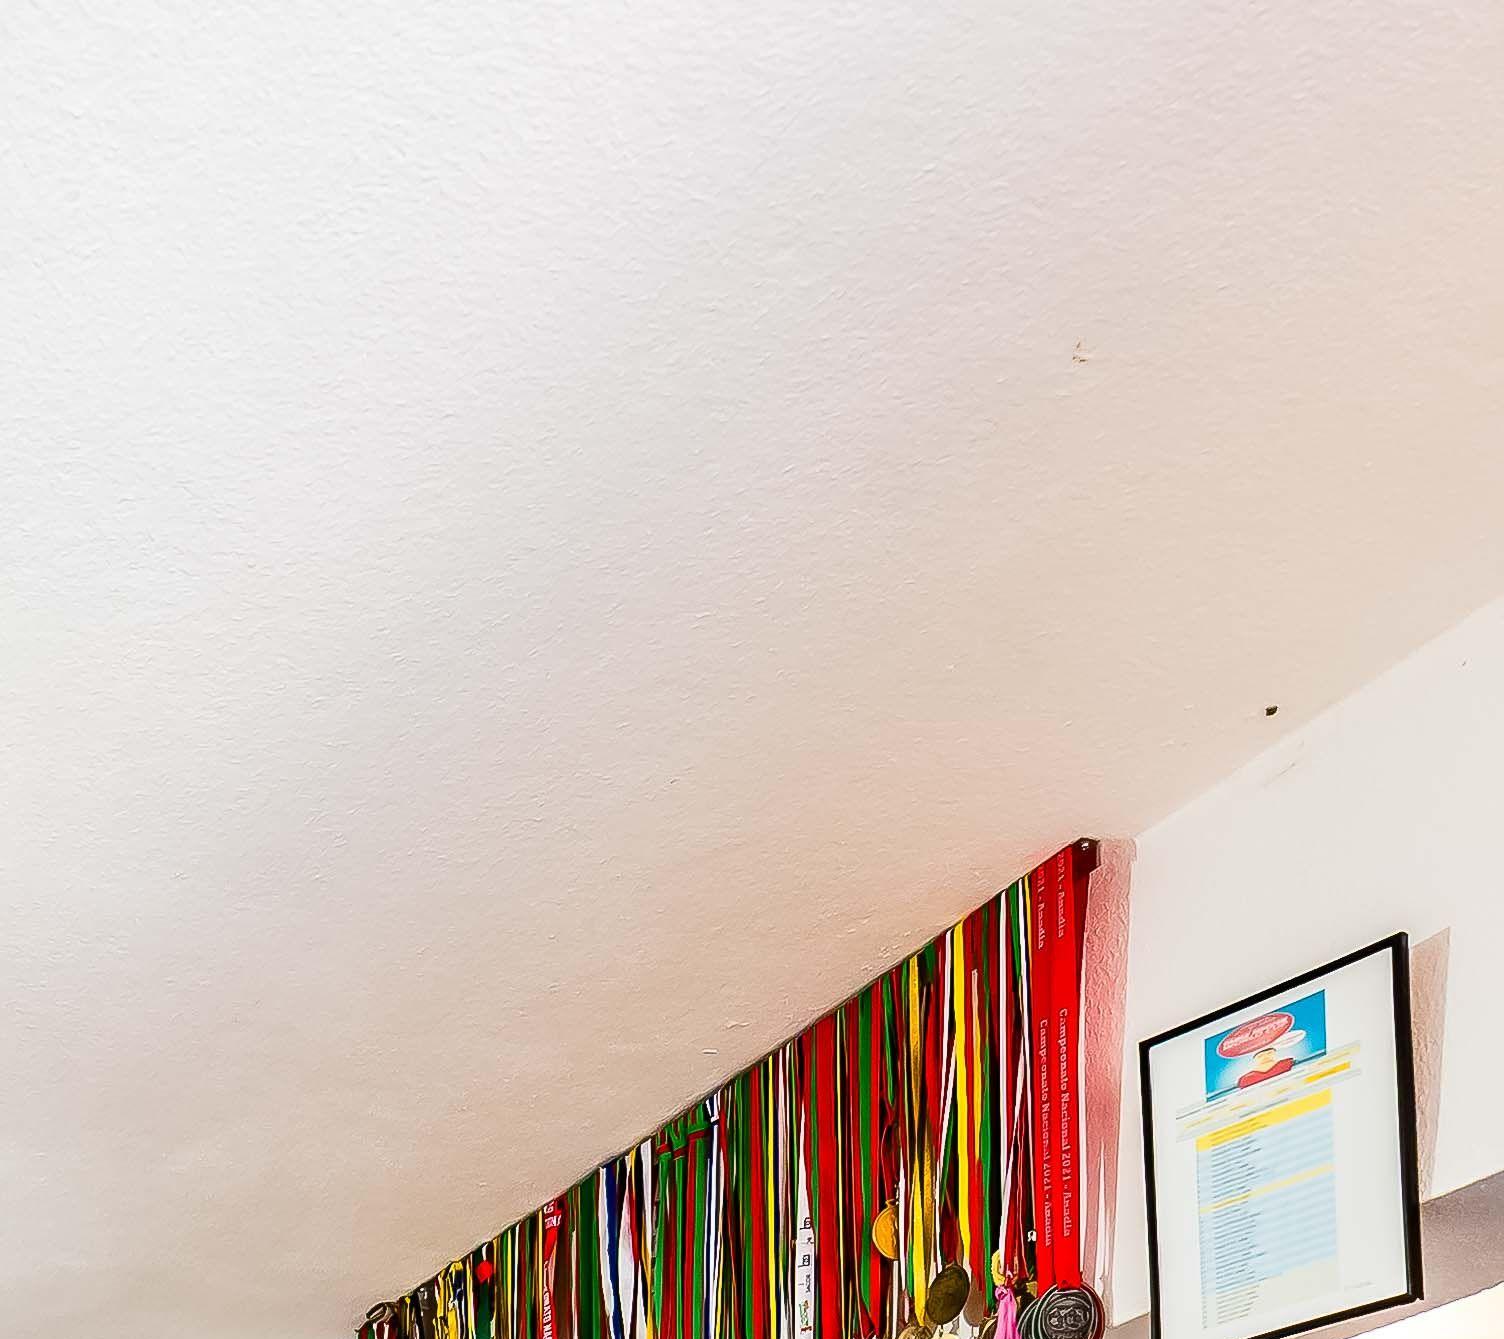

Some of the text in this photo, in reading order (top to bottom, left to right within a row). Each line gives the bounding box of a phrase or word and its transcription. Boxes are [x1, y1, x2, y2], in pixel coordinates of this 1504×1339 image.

[1038, 1019, 1052, 1100] Campeonato
[1057, 1008, 1072, 1090] Campeonato
[1040, 1103, 1052, 1160] Nacional
[1060, 1092, 1072, 1151] Nacional
